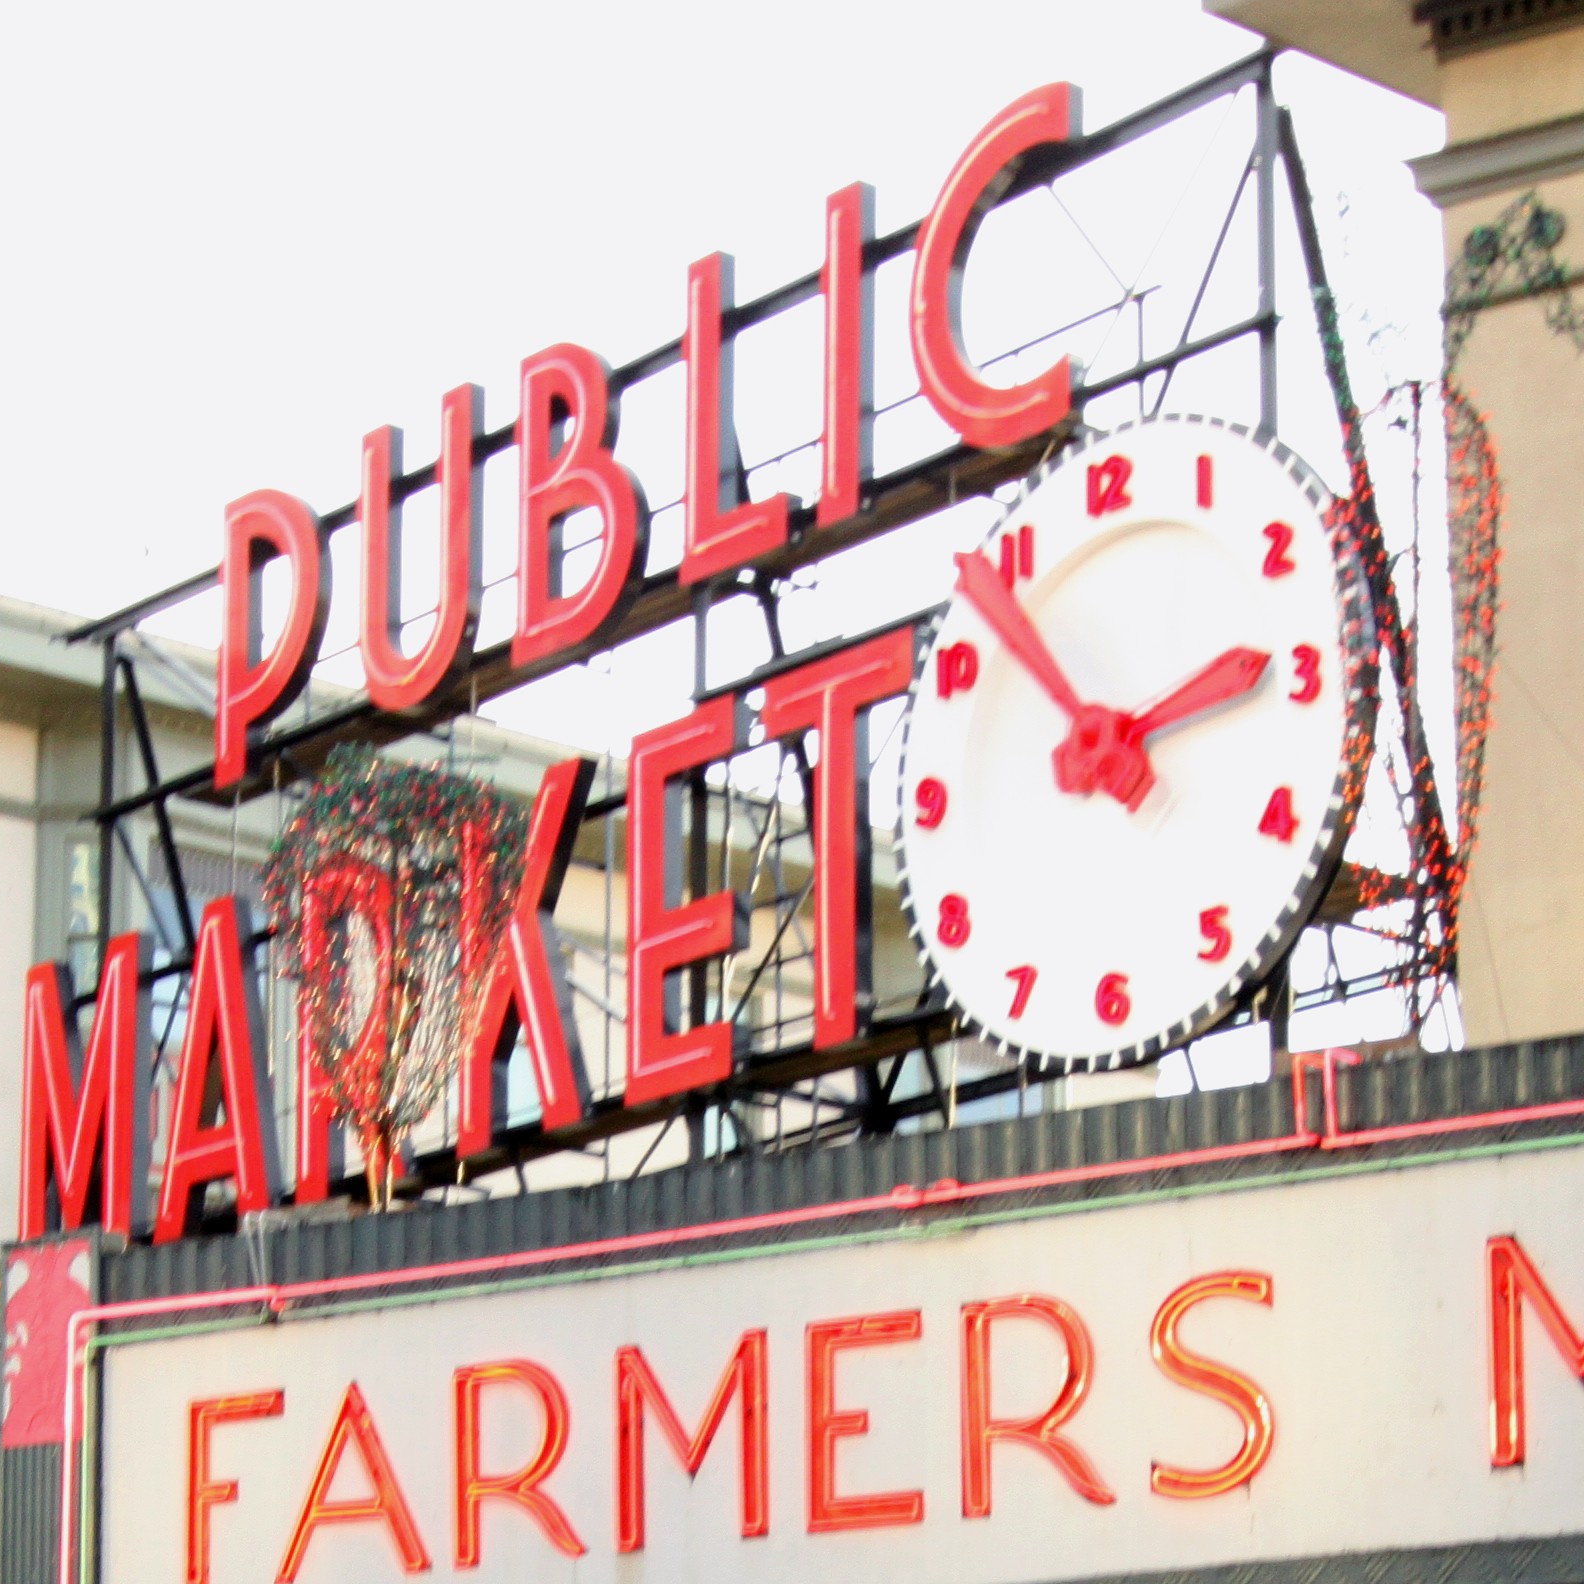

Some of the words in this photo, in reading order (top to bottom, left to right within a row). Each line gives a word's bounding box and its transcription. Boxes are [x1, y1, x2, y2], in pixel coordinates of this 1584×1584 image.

[216, 79, 1082, 786] PUBLIC
[1087, 454, 1134, 518] 12
[1196, 453, 1214, 509] 1
[1261, 520, 1296, 579] 2
[936, 641, 980, 700] 10
[1288, 643, 1323, 704] 3
[915, 776, 949, 831] 9
[1256, 785, 1300, 845] 4
[18, 624, 915, 1245] MARKET
[936, 892, 970, 949] 8
[1197, 905, 1233, 964] 5
[1004, 964, 1039, 1020] 7
[1095, 971, 1132, 1027] 6
